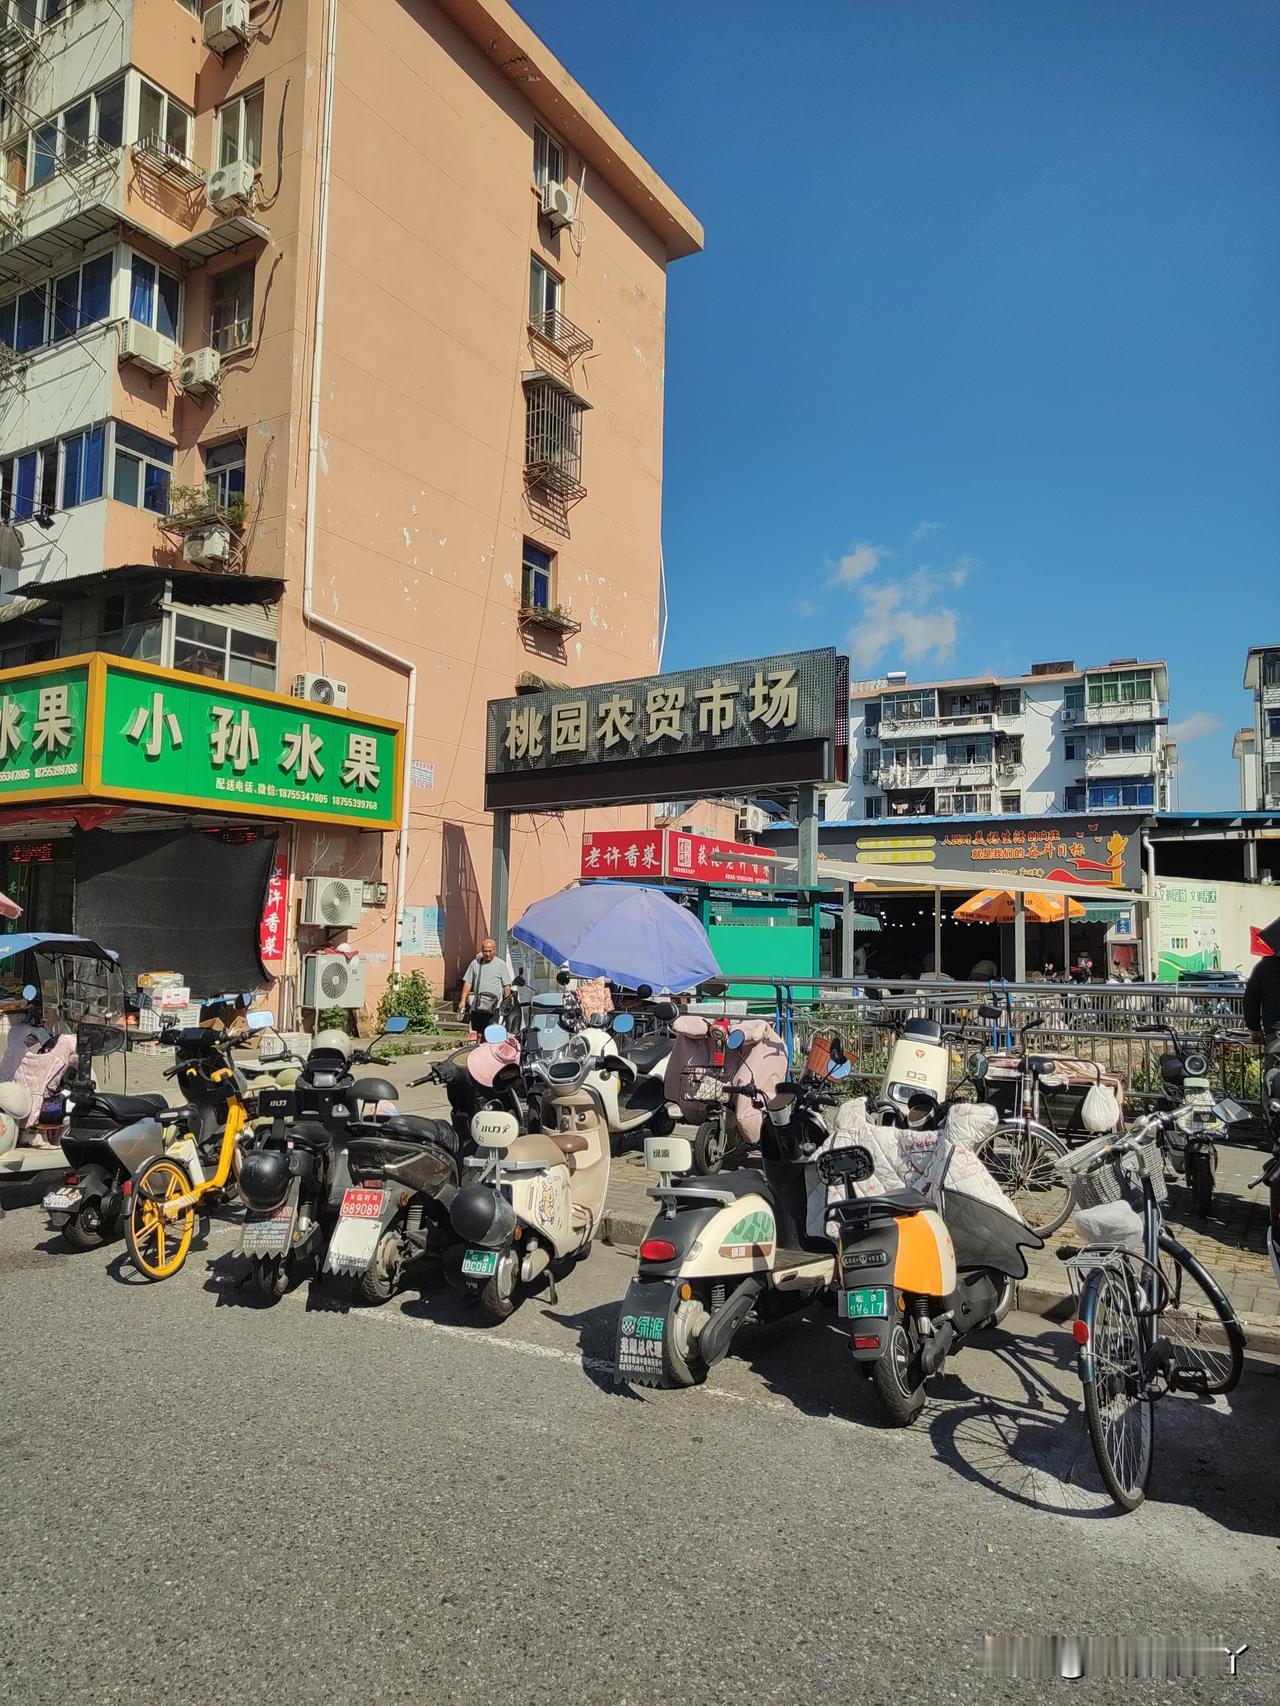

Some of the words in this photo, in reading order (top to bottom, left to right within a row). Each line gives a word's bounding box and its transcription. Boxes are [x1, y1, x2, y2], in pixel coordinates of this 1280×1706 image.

[504, 668, 800, 761] 桃园农贸市场
[126, 692, 382, 790] 小孙水果
[332, 795, 378, 811] 18755399768
[941, 829, 1061, 847] 人民对美好生活的向往
[584, 842, 661, 870] 老许香菜
[971, 842, 1086, 860] 就是我们的奋斗目标
[342, 1203, 380, 1216] G89089
[636, 1316, 665, 1340] 绿源
[620, 1336, 663, 1358] 芜湖总代理
